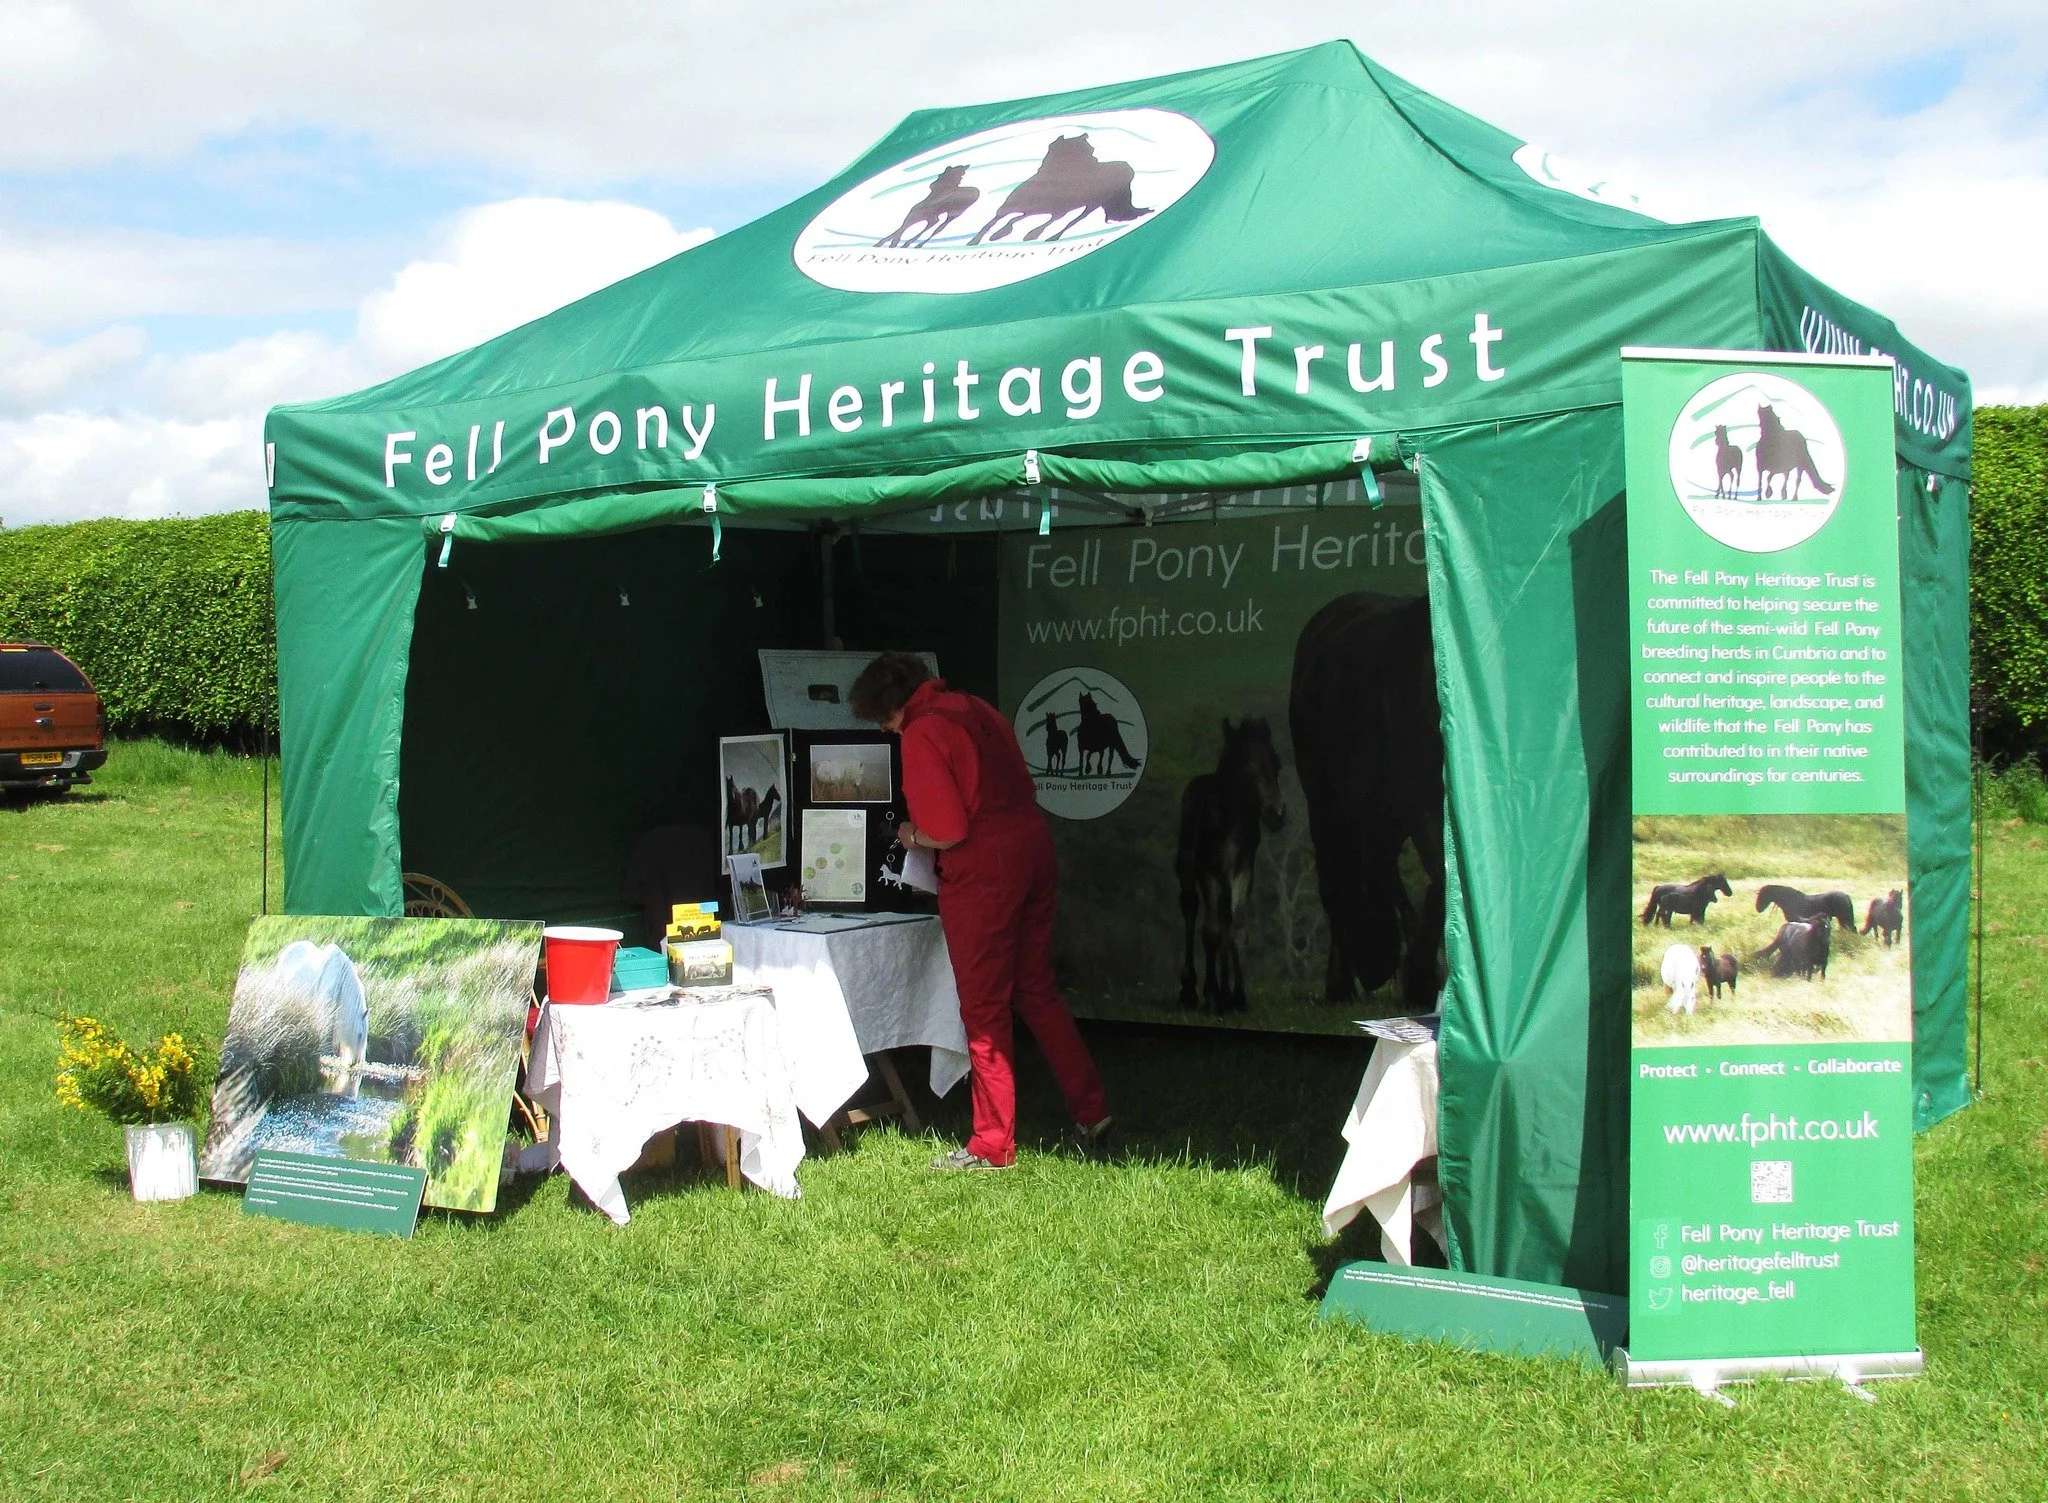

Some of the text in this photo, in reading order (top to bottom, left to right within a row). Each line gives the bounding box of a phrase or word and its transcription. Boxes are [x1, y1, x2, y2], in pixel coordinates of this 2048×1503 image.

[384, 313, 1506, 489] Fell Pony Heritage Trust
[1026, 539, 1102, 590] Fell
[1128, 537, 1244, 590] Pony
[1650, 569, 1875, 589] The Fell Pony Heritage Trust is
[1647, 596, 1878, 614] committed to helping secure the
[1026, 598, 1264, 647] www.fpht.co.uk
[1647, 620, 1880, 640] future of the semi-wild Fell Pony
[1642, 644, 1886, 662] breeding herds in Cumbria and to
[1644, 671, 1885, 688] connect and inspire people to the
[1646, 695, 1700, 709] cultural
[1854, 695, 1884, 709] and
[1658, 719, 1871, 737] wildlife that the Fell Pony has
[1663, 743, 1868, 758] contributed to in their native
[1668, 768, 1863, 786] surroundings for centuries.
[1046, 783, 1066, 792] Pony
[1070, 782, 1108, 791] Heritage
[1111, 782, 1132, 790] Trust
[1639, 1059, 1901, 1078] Protect Connect Collaborate
[1662, 1110, 1878, 1148] www.fpht.co.uk
[1681, 1220, 1899, 1245] Fell Pony Heritage Trust
[1681, 1252, 1840, 1275] @heritagefelltrust
[1681, 1281, 1795, 1304] heritage_fell
